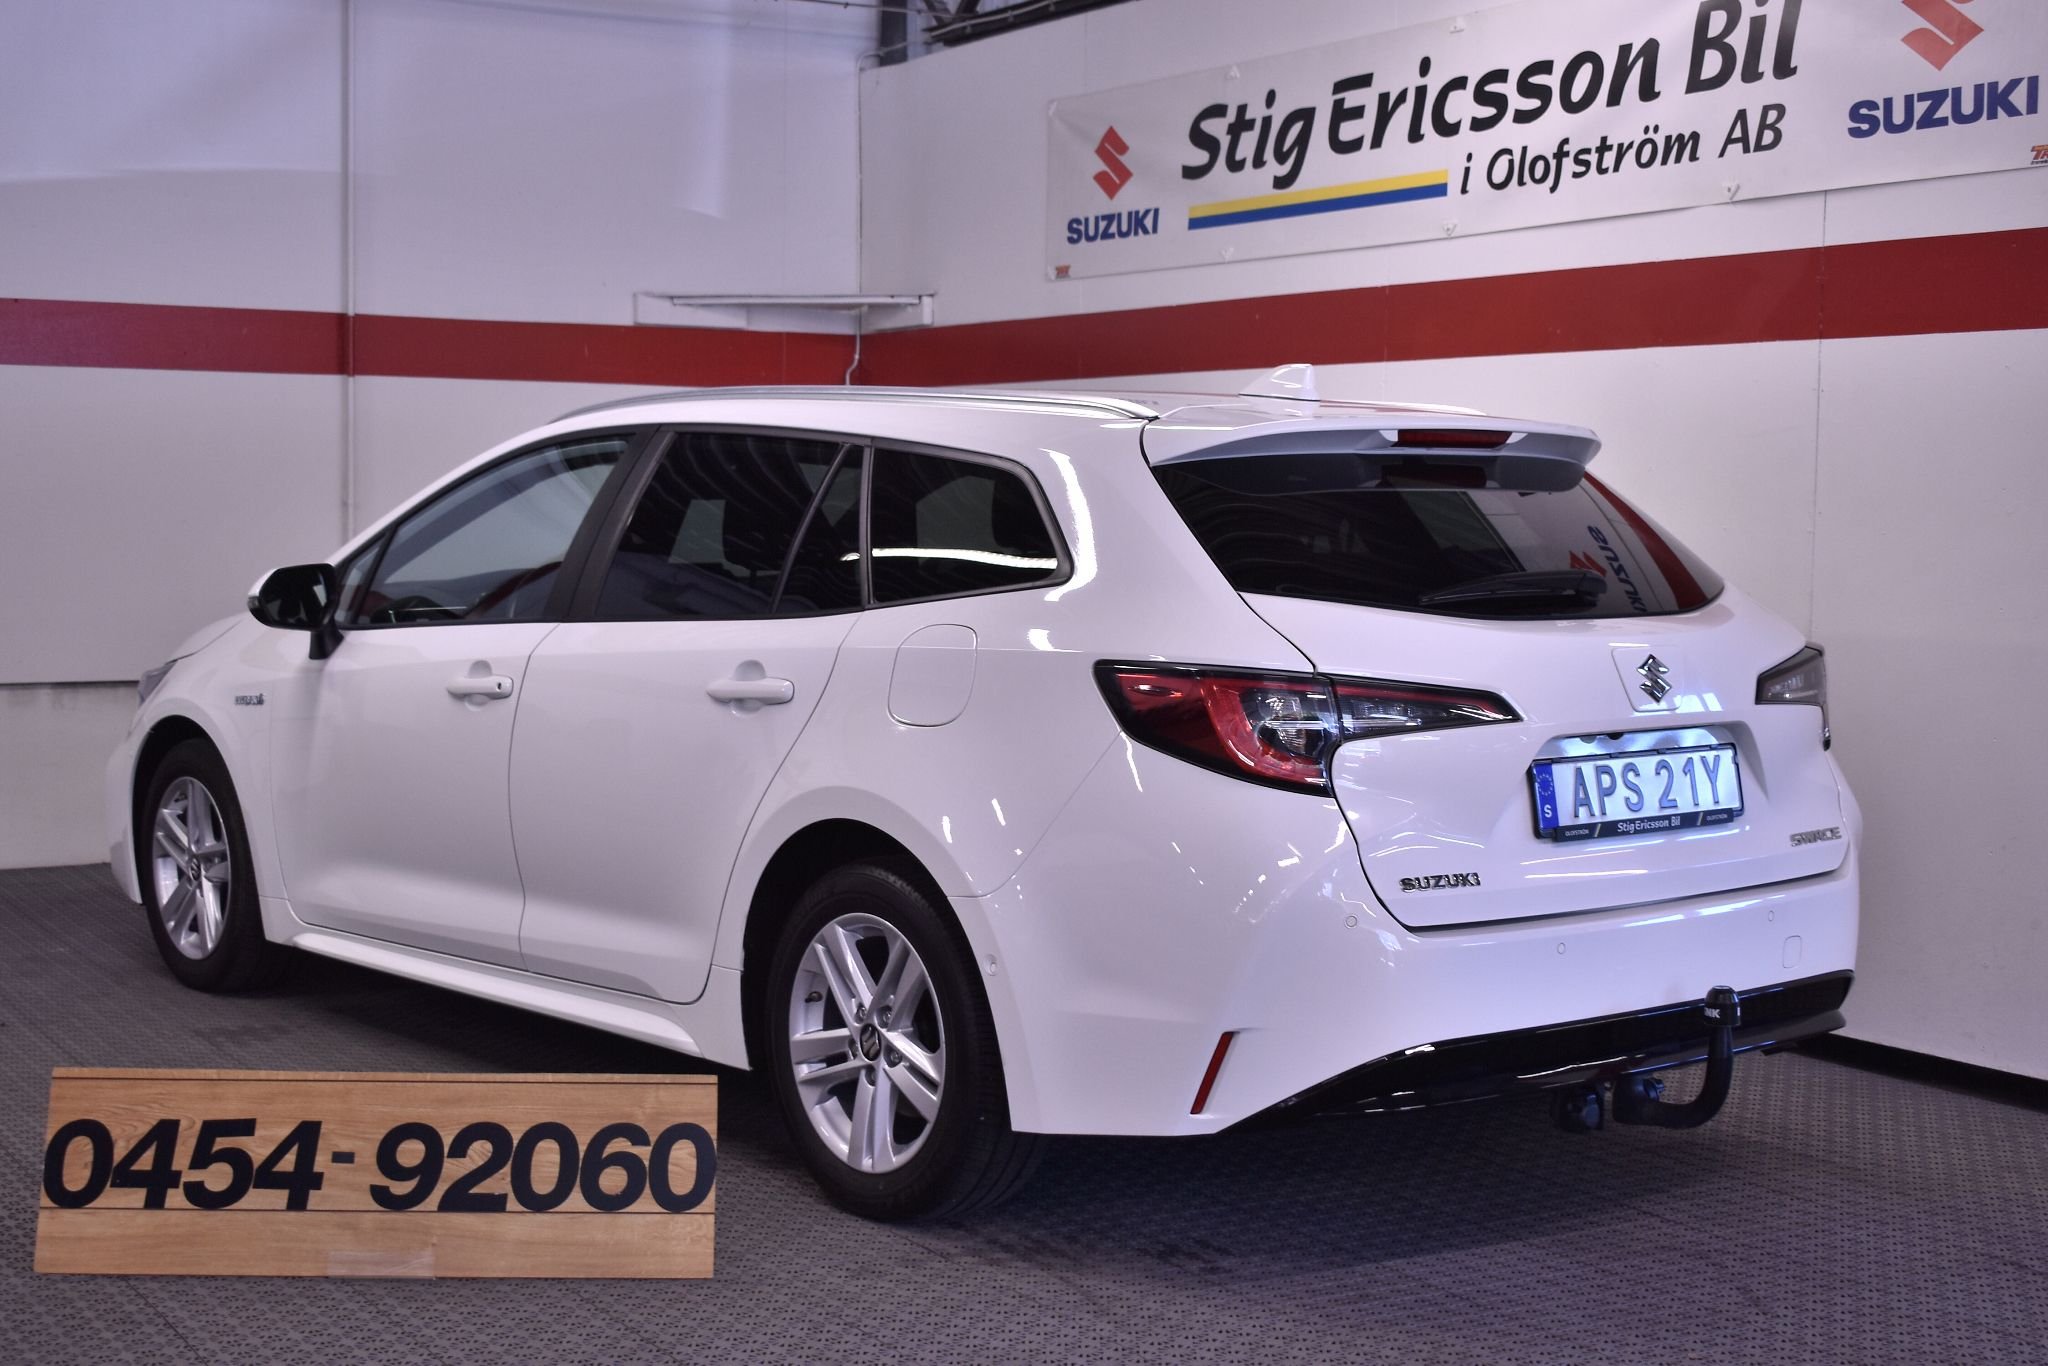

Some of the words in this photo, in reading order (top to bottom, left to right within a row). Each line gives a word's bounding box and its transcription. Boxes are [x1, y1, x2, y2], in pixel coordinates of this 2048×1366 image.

[1182, 89, 1316, 190] Stig
[1328, 37, 1661, 156] Ericsson
[1685, 0, 1802, 95] Bil
[1847, 75, 2040, 140] SUZUKI
[1460, 153, 1473, 195] i
[1486, 125, 1701, 195] Olofström
[1719, 103, 1787, 159] AB
[1067, 207, 1160, 245] SUZUKI
[1544, 804, 1553, 818] S
[1574, 761, 1645, 818] APS
[1655, 754, 1721, 809] 21Y
[1617, 820, 1635, 833] Stig
[1635, 818, 1669, 831] Ericsson
[1671, 816, 1681, 826] Bil
[1400, 872, 1481, 893] SUZUKI
[42, 1118, 717, 1213] 0454-92060
